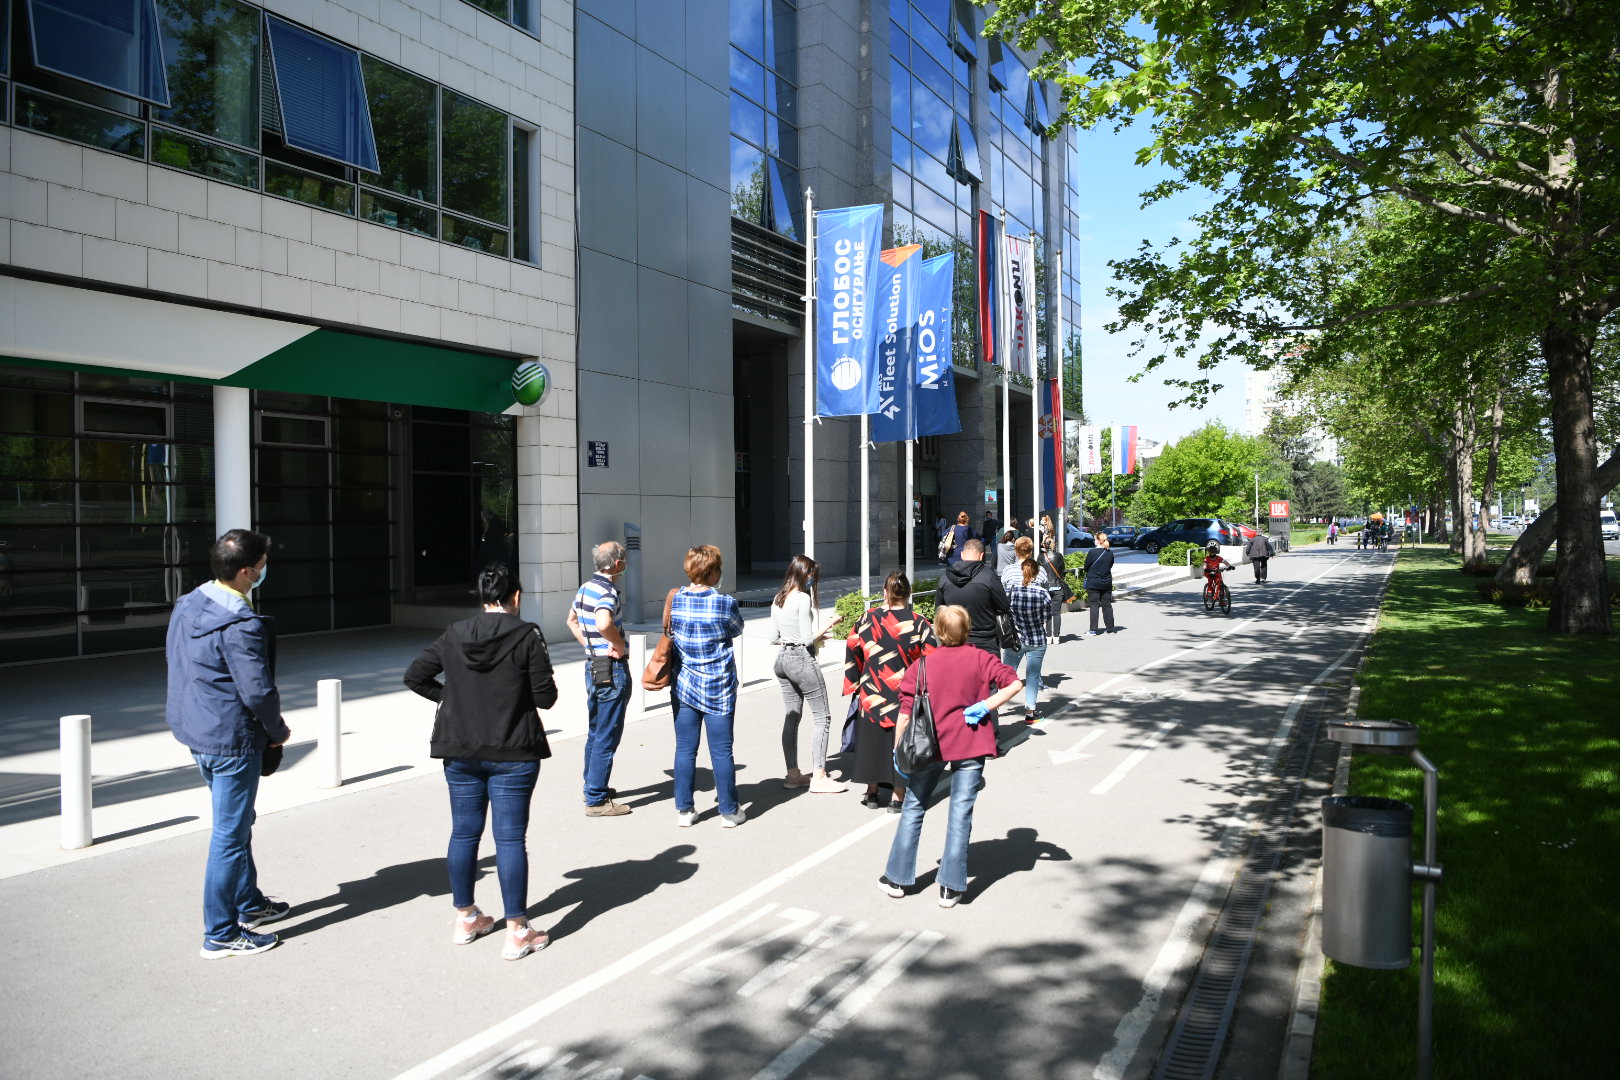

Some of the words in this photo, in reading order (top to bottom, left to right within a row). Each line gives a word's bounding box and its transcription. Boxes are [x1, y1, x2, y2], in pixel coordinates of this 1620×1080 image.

[832, 238, 852, 345] ГЛОБОС
[852, 241, 865, 340] ОСИГУРАЊЕ
[885, 273, 902, 344] Solution
[883, 348, 896, 392] Fleet
[918, 310, 939, 390] MiOS
[1272, 504, 1286, 516] LUK
